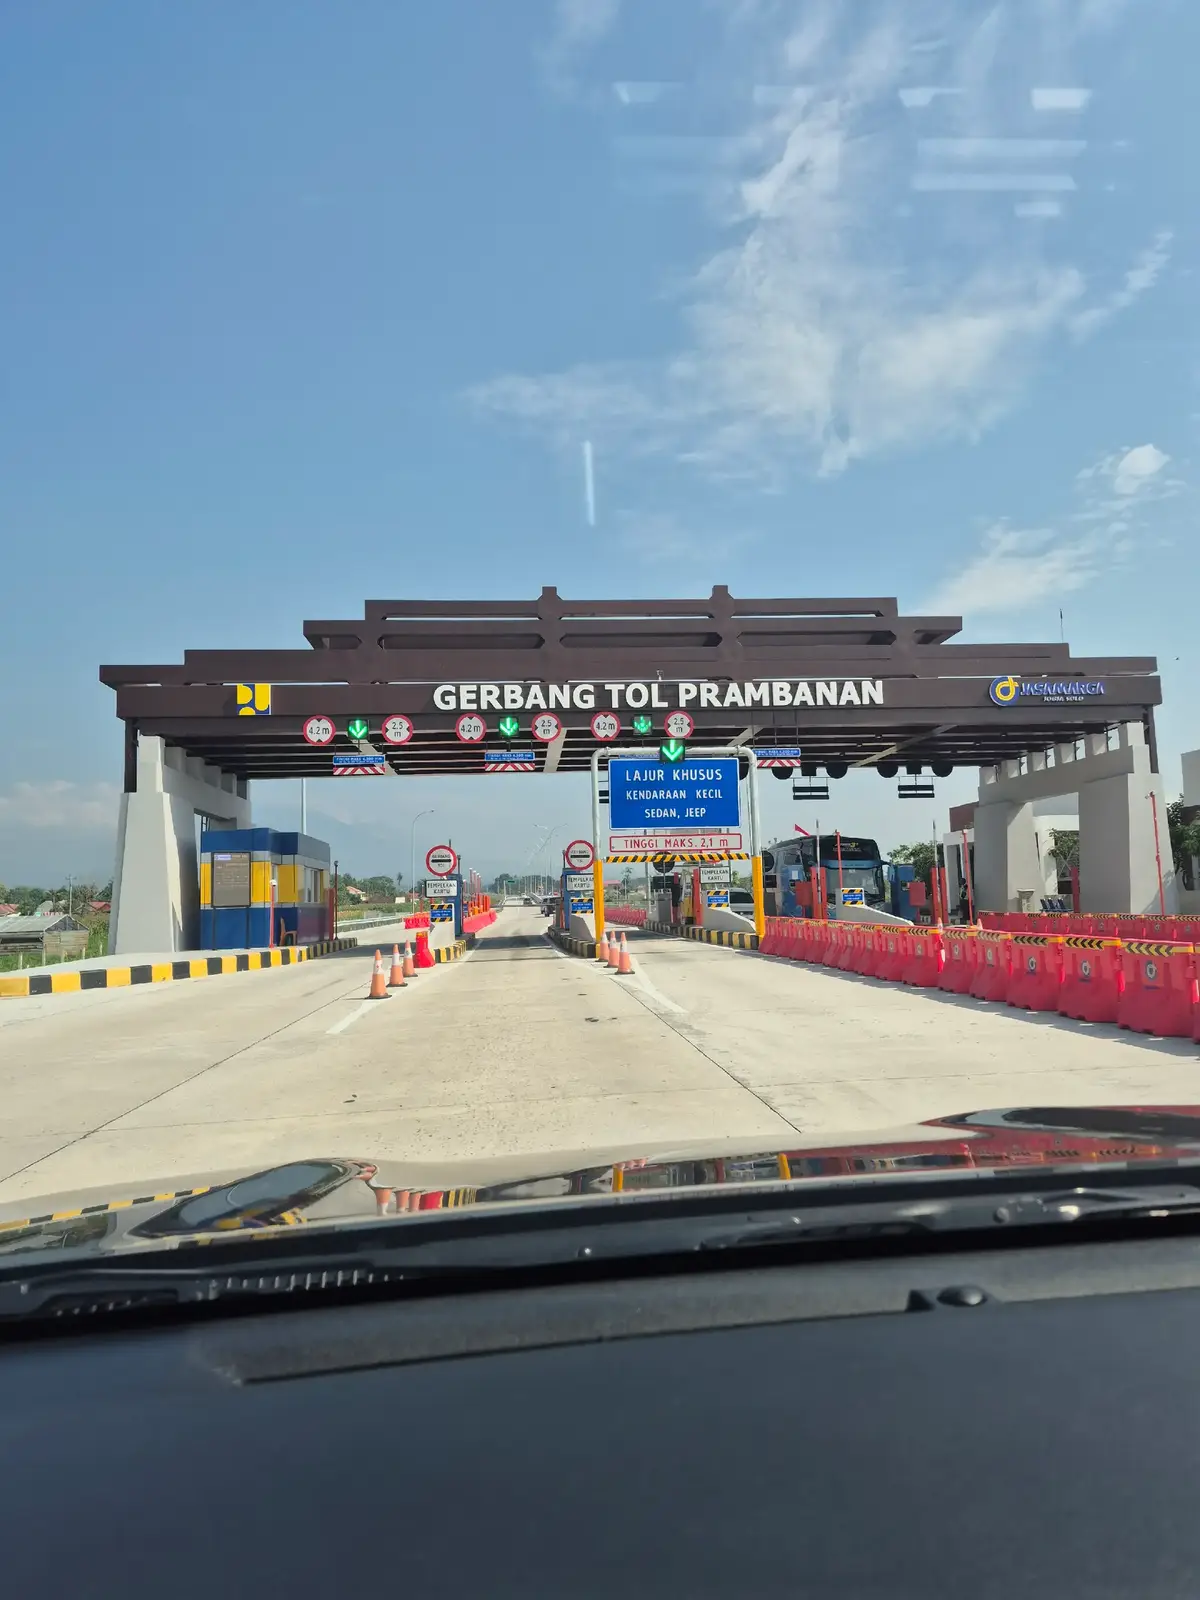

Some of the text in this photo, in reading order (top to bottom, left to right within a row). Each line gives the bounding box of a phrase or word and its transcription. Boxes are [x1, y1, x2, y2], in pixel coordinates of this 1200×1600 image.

[433, 680, 884, 710] GERBANG TOL PRAMBANAN
[541, 719, 552, 727] 2.5
[673, 717, 684, 725] 2.5
[391, 722, 403, 730] 2.5
[460, 724, 472, 732] 4.2
[596, 722, 607, 730] 4.2
[308, 727, 330, 735] 4.2 m
[625, 768, 722, 781] LAJUR KHUSUS
[626, 788, 723, 800] KENDARAAN KECIL
[644, 807, 706, 819] SEDAN, JEEP
[624, 837, 728, 849] TINGGI MAKS. 2,1 m
